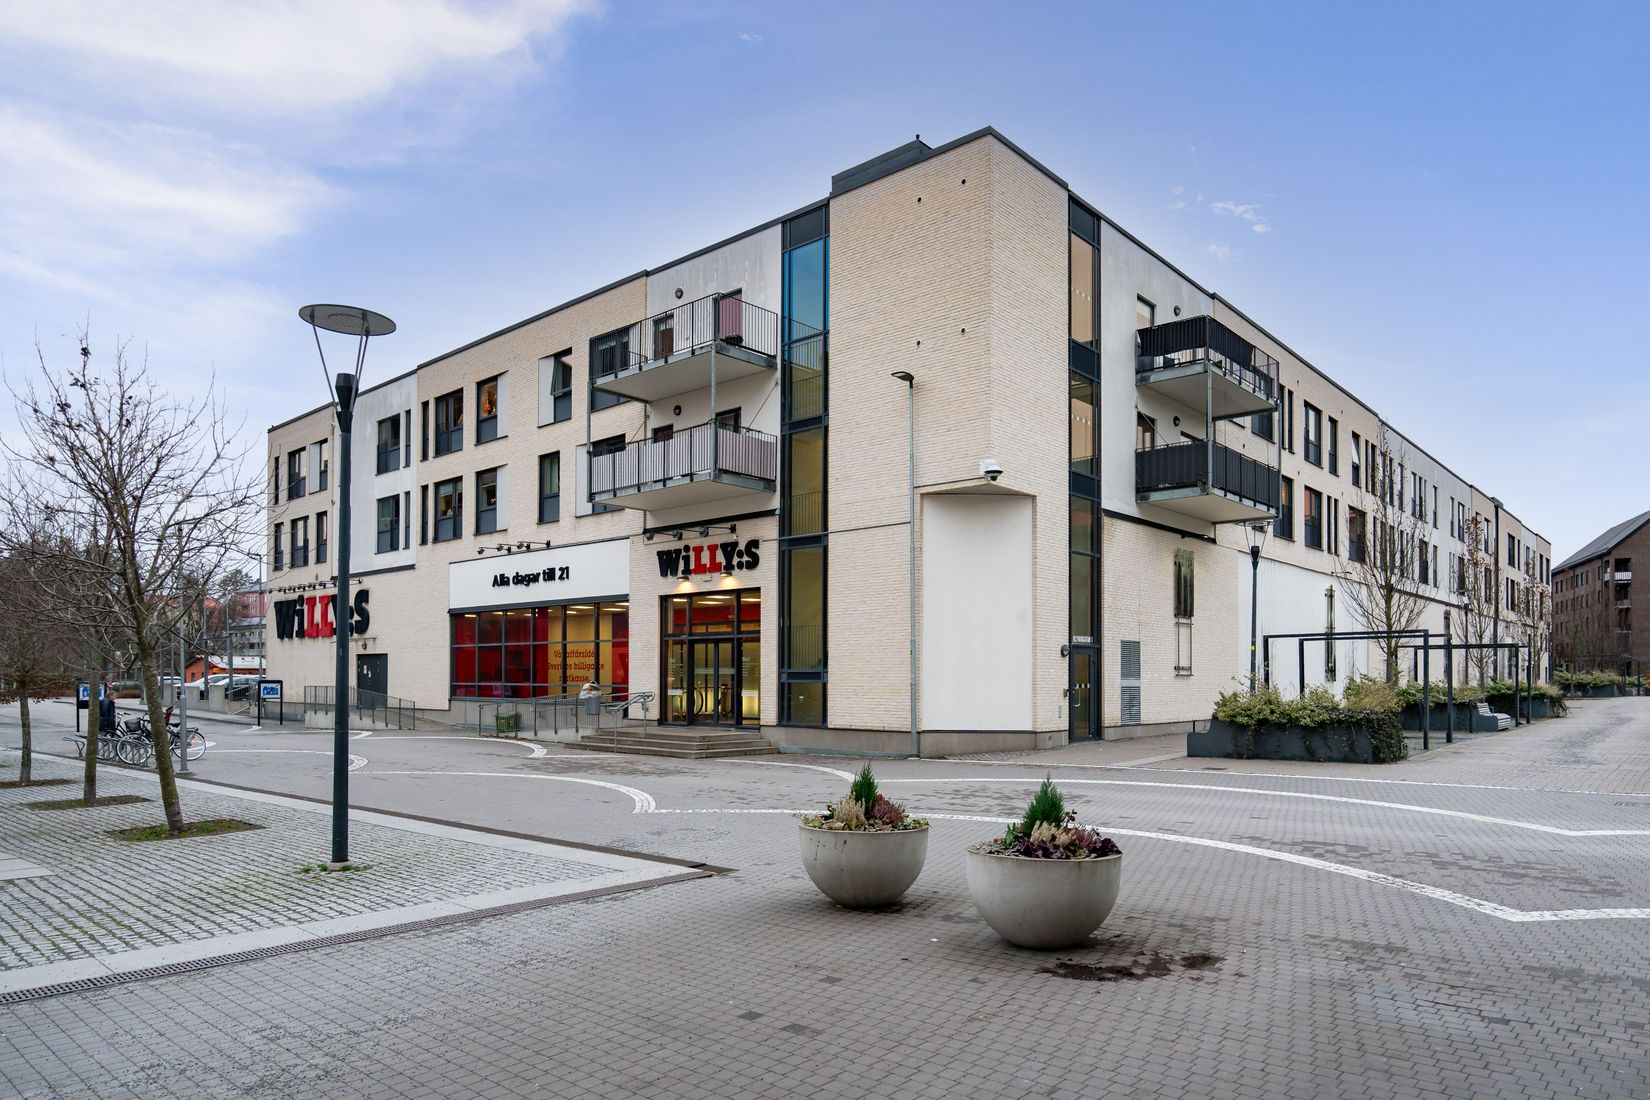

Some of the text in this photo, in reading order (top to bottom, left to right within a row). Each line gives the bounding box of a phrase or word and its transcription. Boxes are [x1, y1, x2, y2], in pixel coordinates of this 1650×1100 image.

[492, 566, 570, 588] Alla dagar till 21
[546, 661, 572, 670] Sveries
